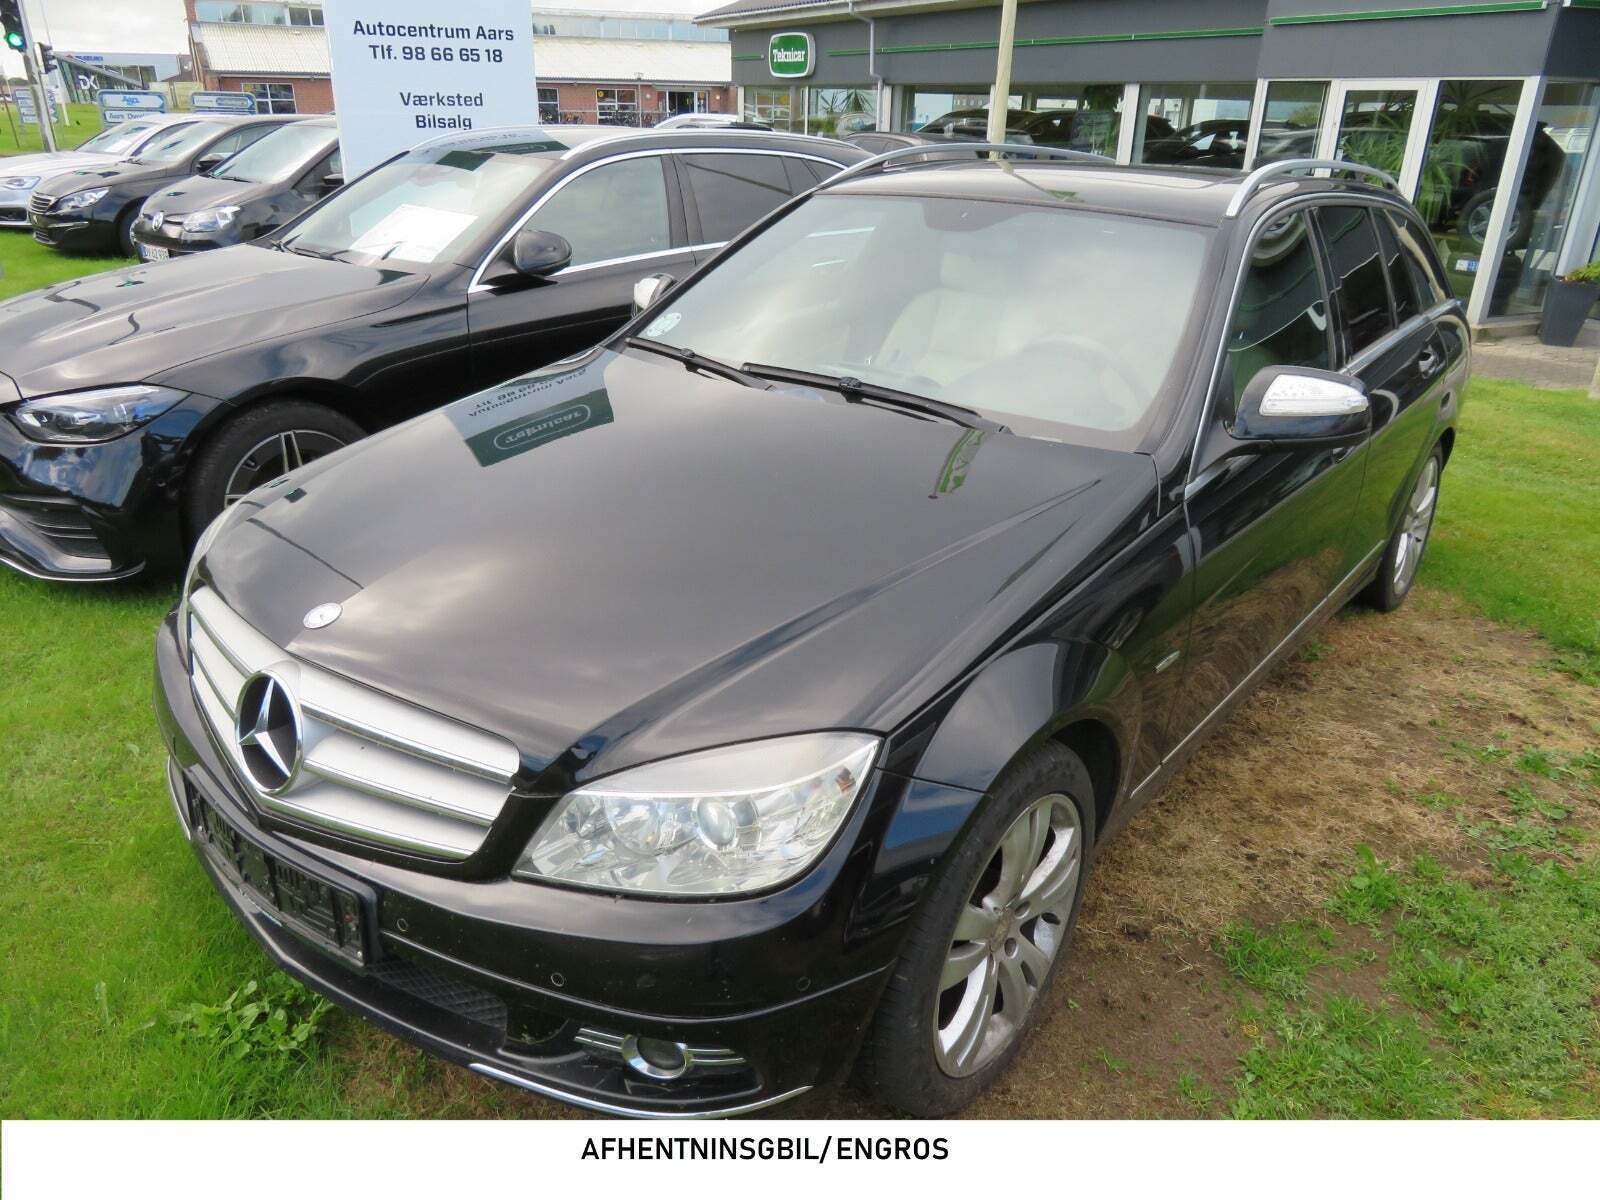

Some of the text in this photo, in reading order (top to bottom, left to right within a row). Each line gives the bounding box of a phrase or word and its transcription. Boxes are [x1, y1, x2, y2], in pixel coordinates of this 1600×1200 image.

[353, 20, 514, 41] Autocentrum Aars
[368, 44, 503, 63] Tlf. 98 66 65 18
[772, 47, 806, 62] Teknicar
[400, 92, 483, 107] Værksted
[415, 114, 472, 130] Bilsalg
